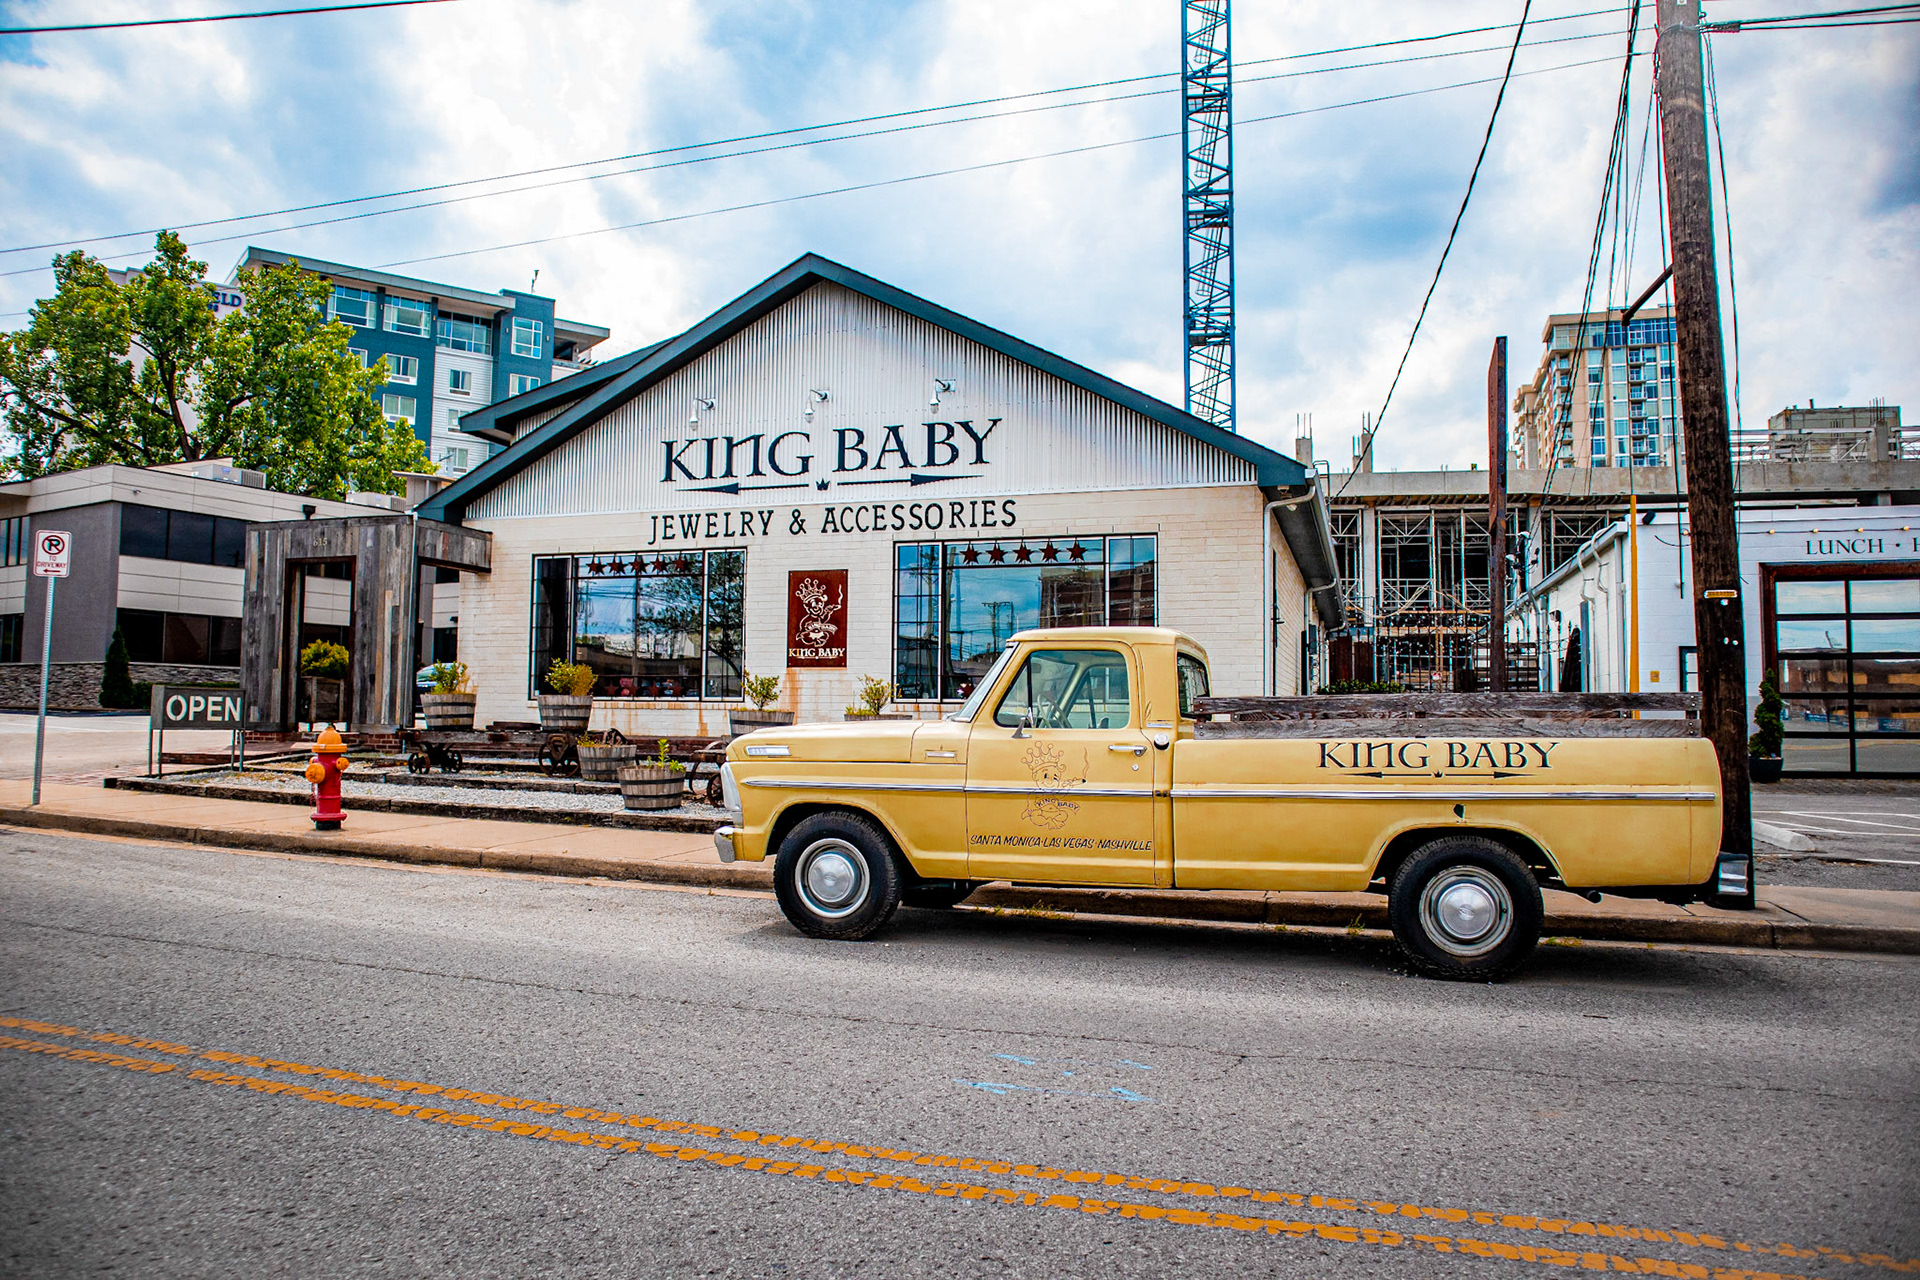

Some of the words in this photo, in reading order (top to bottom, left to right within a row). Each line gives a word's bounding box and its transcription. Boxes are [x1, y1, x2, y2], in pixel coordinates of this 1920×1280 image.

[832, 418, 1003, 473] BABY
[648, 509, 774, 545] JEWELRY
[789, 508, 807, 535] &
[821, 499, 1017, 534] ACCESSORIES
[1806, 538, 1884, 555] LUNCH
[818, 648, 845, 657] BABY
[166, 694, 242, 722] OPEN
[1444, 741, 1561, 768] BABY
[1057, 801, 1080, 811] BABY
[970, 834, 1001, 846] SANTA
[1063, 837, 1095, 850] VEGAS
[1097, 839, 1152, 851] NASHVILLE
